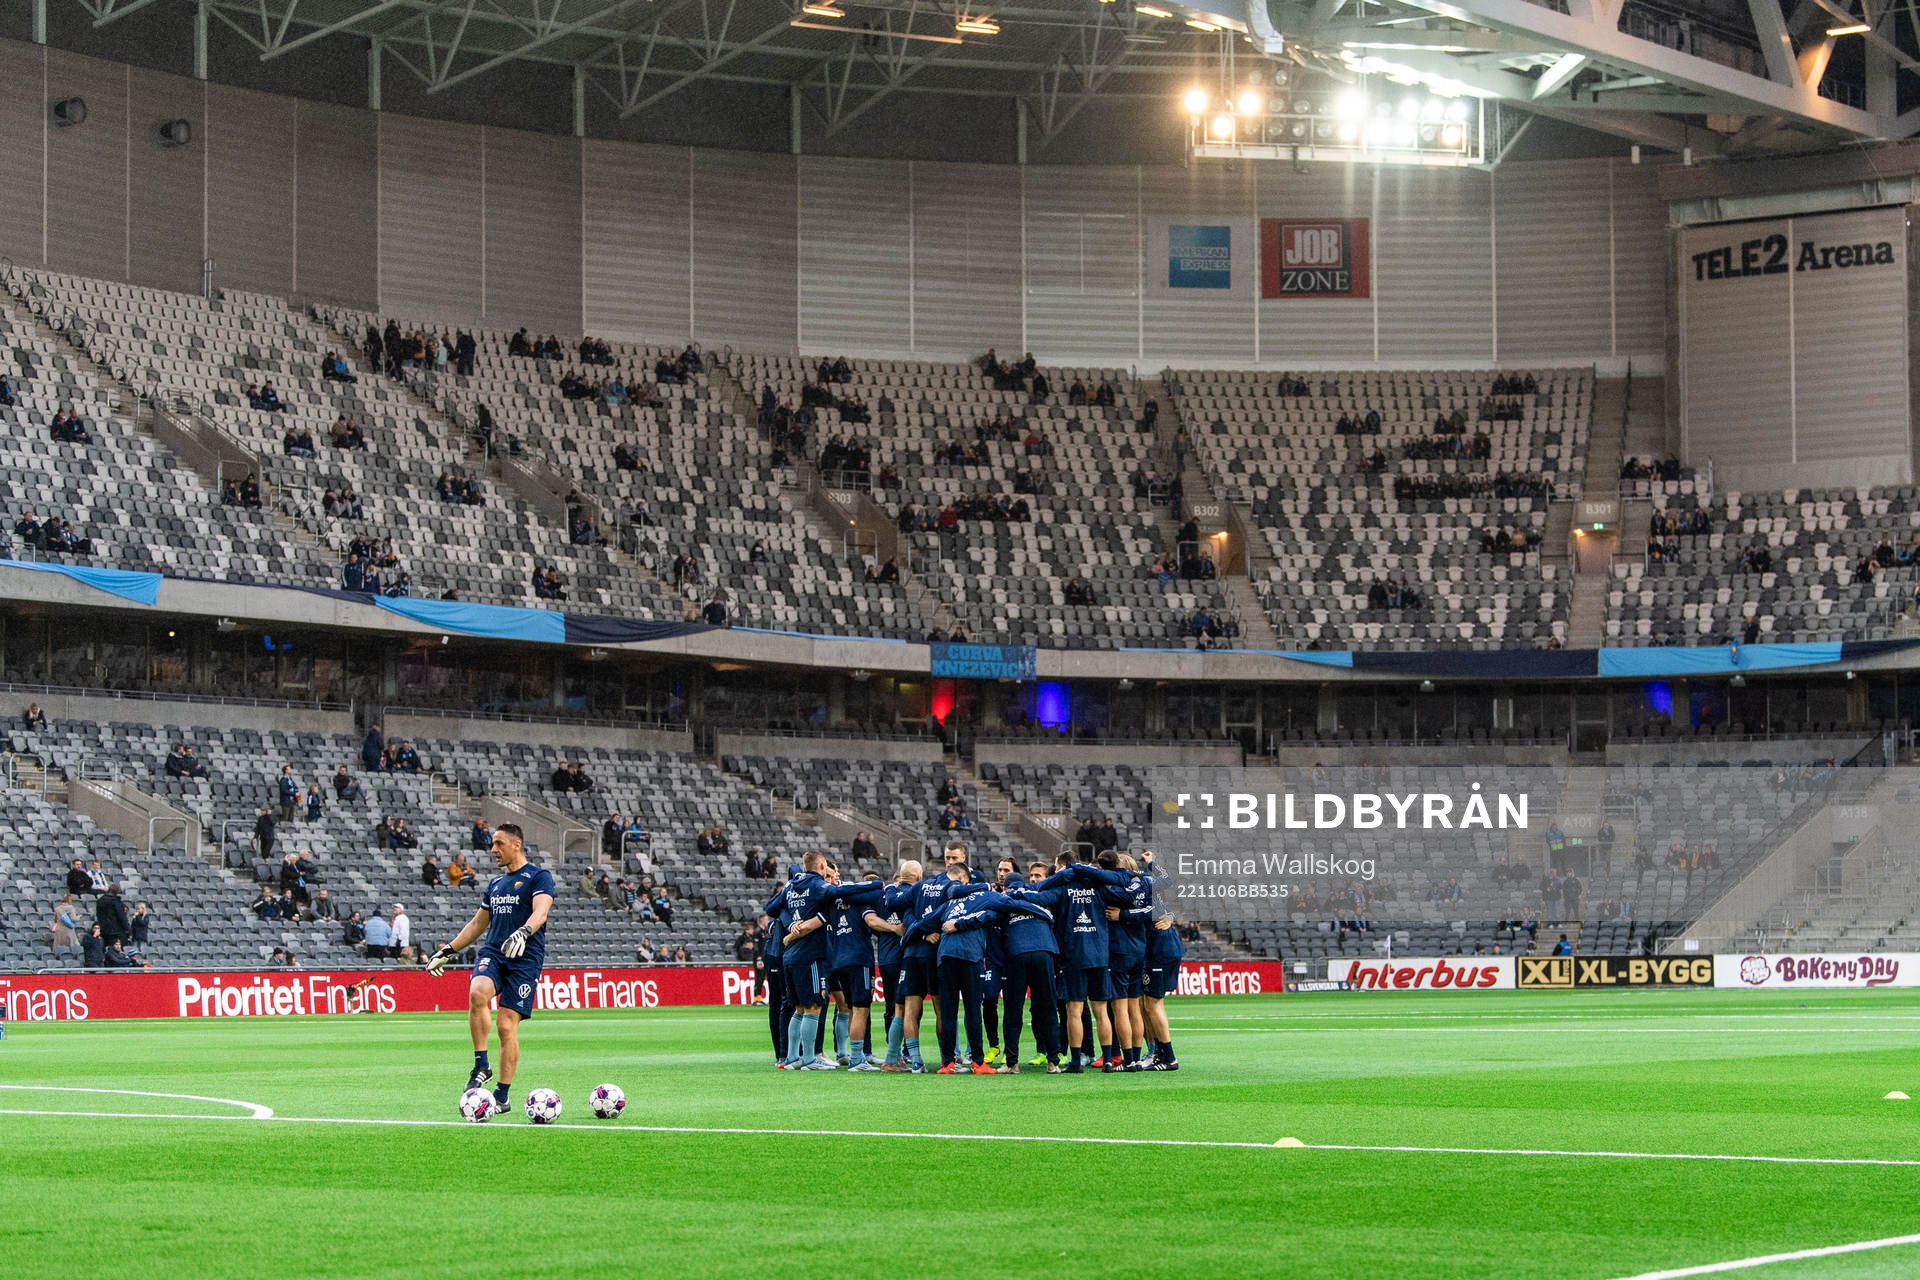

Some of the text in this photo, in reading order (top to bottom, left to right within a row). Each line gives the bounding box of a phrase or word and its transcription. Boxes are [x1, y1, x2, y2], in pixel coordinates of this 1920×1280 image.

[1286, 229, 1339, 264] JOB
[1692, 234, 1895, 282] TELE2 Arena
[1180, 259, 1232, 271] EXPRESS
[1281, 271, 1349, 291] ZONE
[1193, 506, 1220, 517] B302
[1586, 504, 1612, 514] B301
[947, 644, 1003, 660] CURVA
[1347, 960, 1500, 989] Interbus
[1522, 960, 1570, 983] XL
[1578, 959, 1712, 984] XL-BYGG
[178, 975, 396, 1017] Prioritet Finans
[583, 972, 659, 1009] Finans
